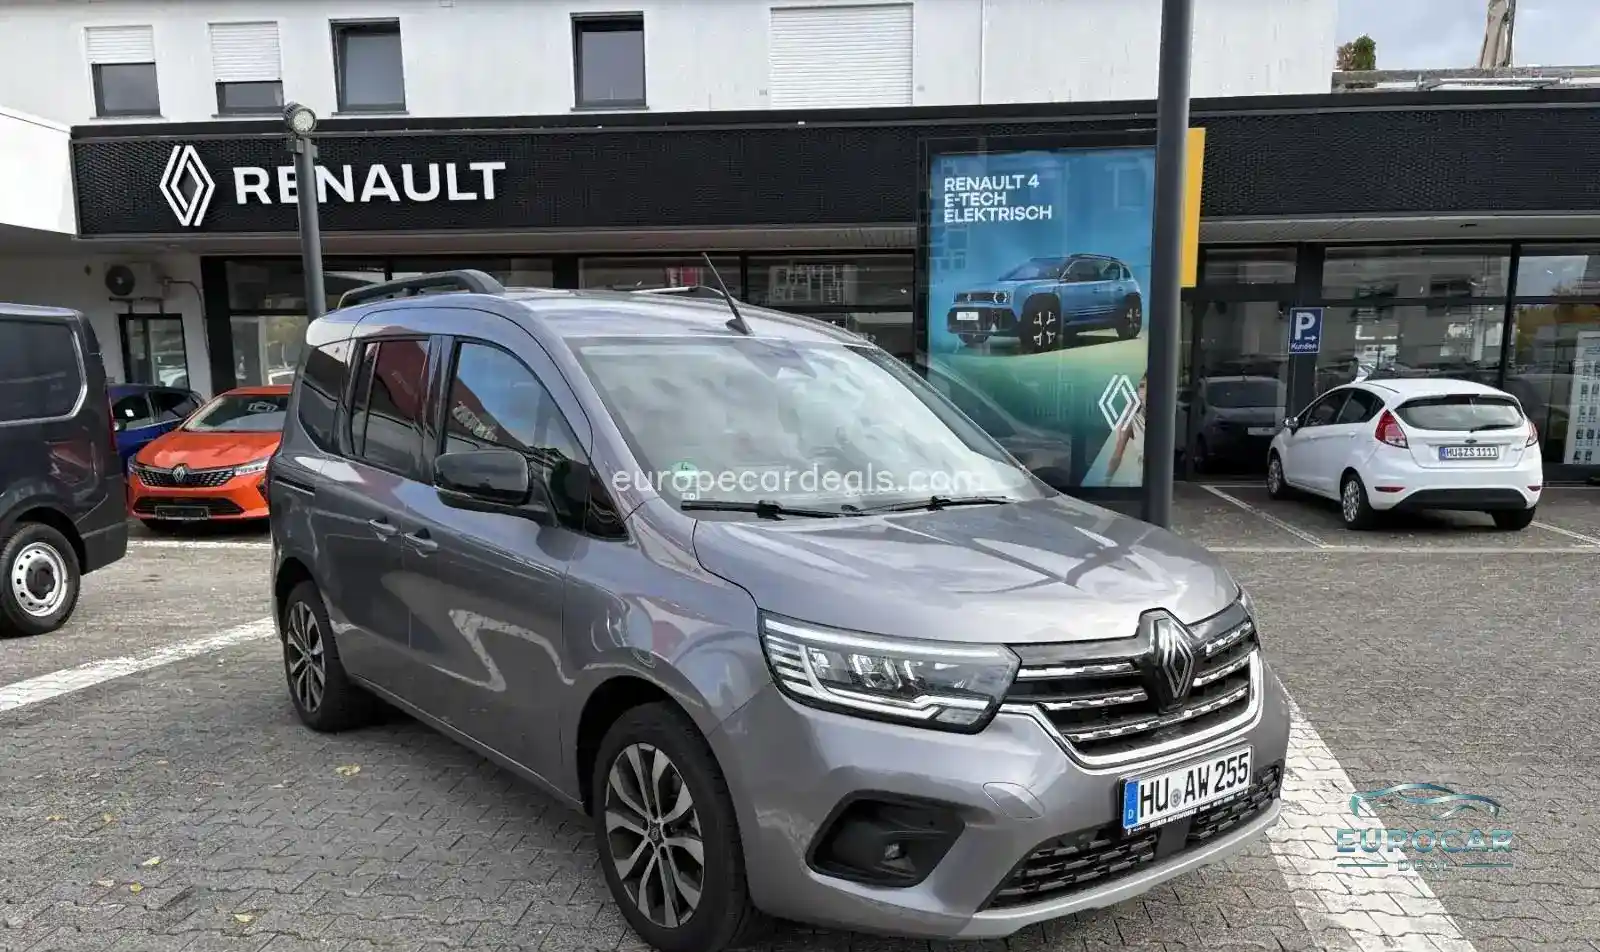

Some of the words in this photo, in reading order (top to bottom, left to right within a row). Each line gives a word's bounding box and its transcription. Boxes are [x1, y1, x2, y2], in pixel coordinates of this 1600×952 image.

[233, 161, 506, 205] RENAULT
[944, 174, 1025, 191] RENAULT
[1027, 173, 1040, 188] 4
[944, 191, 1006, 207] E-TECH
[944, 205, 1053, 223] ELEKTRISCH
[1295, 312, 1316, 340] P
[1291, 342, 1317, 350] Kunden
[1477, 447, 1498, 457] 1111
[1140, 778, 1169, 817] HU
[1184, 765, 1209, 803] AW
[1214, 752, 1249, 791] 255
